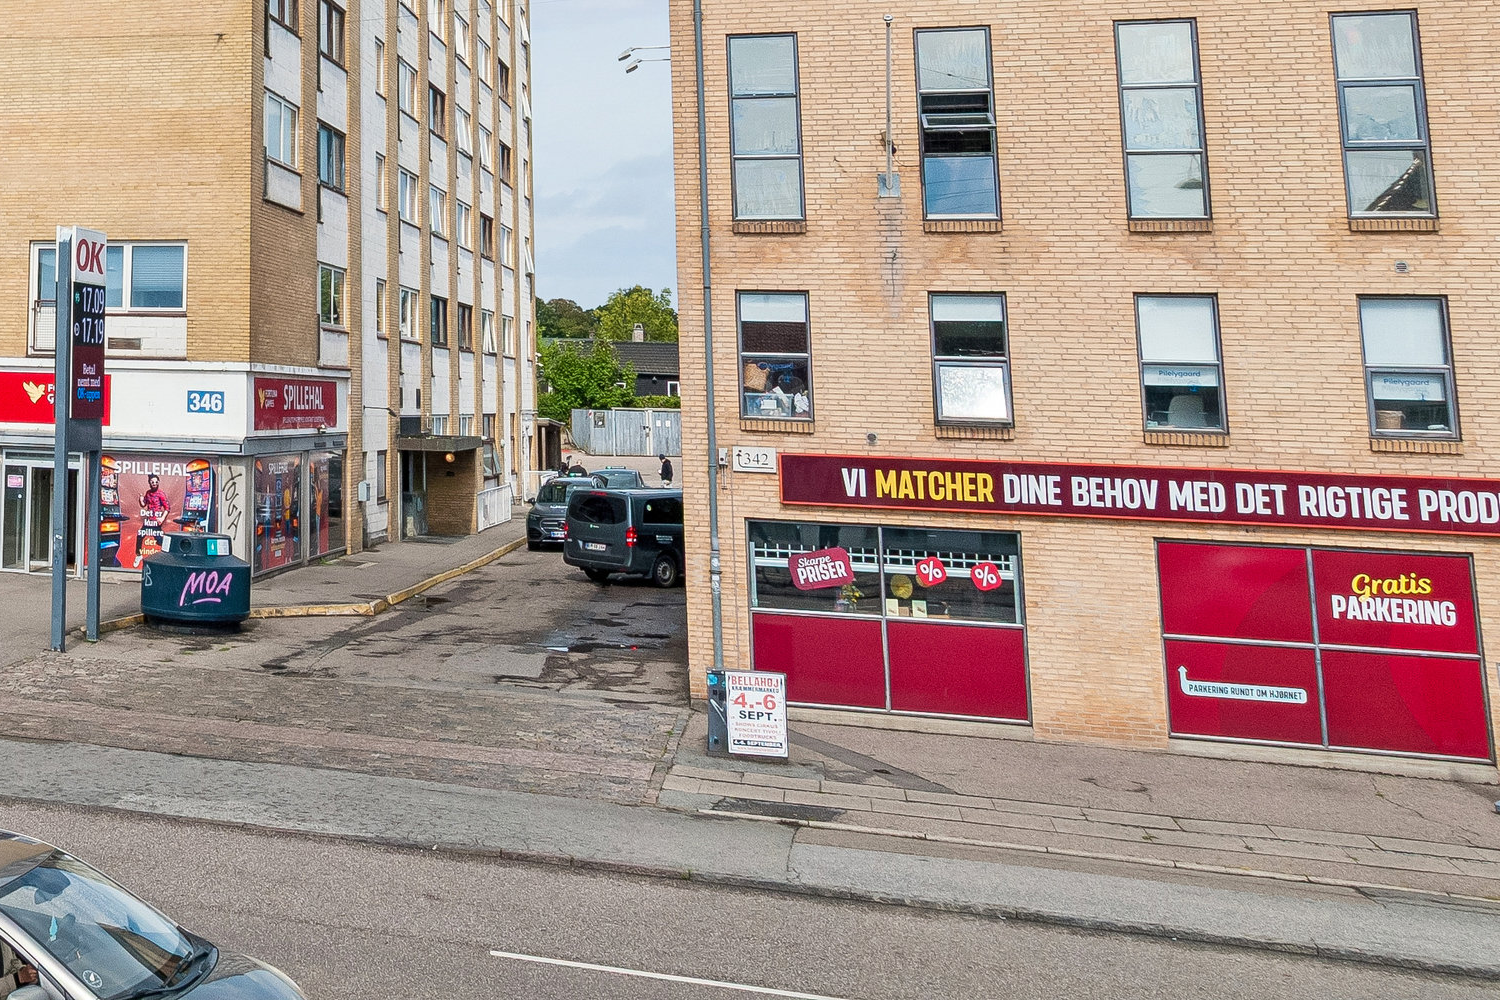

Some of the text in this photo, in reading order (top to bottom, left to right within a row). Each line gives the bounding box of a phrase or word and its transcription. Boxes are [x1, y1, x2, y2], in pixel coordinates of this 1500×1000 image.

[76, 239, 105, 275] OK
[82, 286, 104, 314] 17.09
[82, 317, 104, 344] 17.19
[189, 393, 223, 412] 346
[283, 384, 324, 410] SPILLEHAL
[744, 452, 769, 466] 342
[114, 460, 190, 477] SPILLEHAL
[841, 467, 1500, 524] VI MATCHER DINE BEHOV MED DET RIGTIGE PROD
[140, 509, 153, 517] Det
[144, 518, 158, 527] kun
[138, 528, 164, 537] spillere
[144, 538, 157, 546] der
[797, 554, 832, 569] Skarpe
[796, 560, 848, 585] PRISER
[180, 571, 232, 607] MOA
[1351, 572, 1432, 603] Gratis
[1331, 594, 1457, 627] PARKERING
[1188, 683, 1302, 700] PARKERING RUNDT OM HJØRNET
[733, 692, 777, 710] 4.-6
[739, 710, 777, 722] SEPT.
